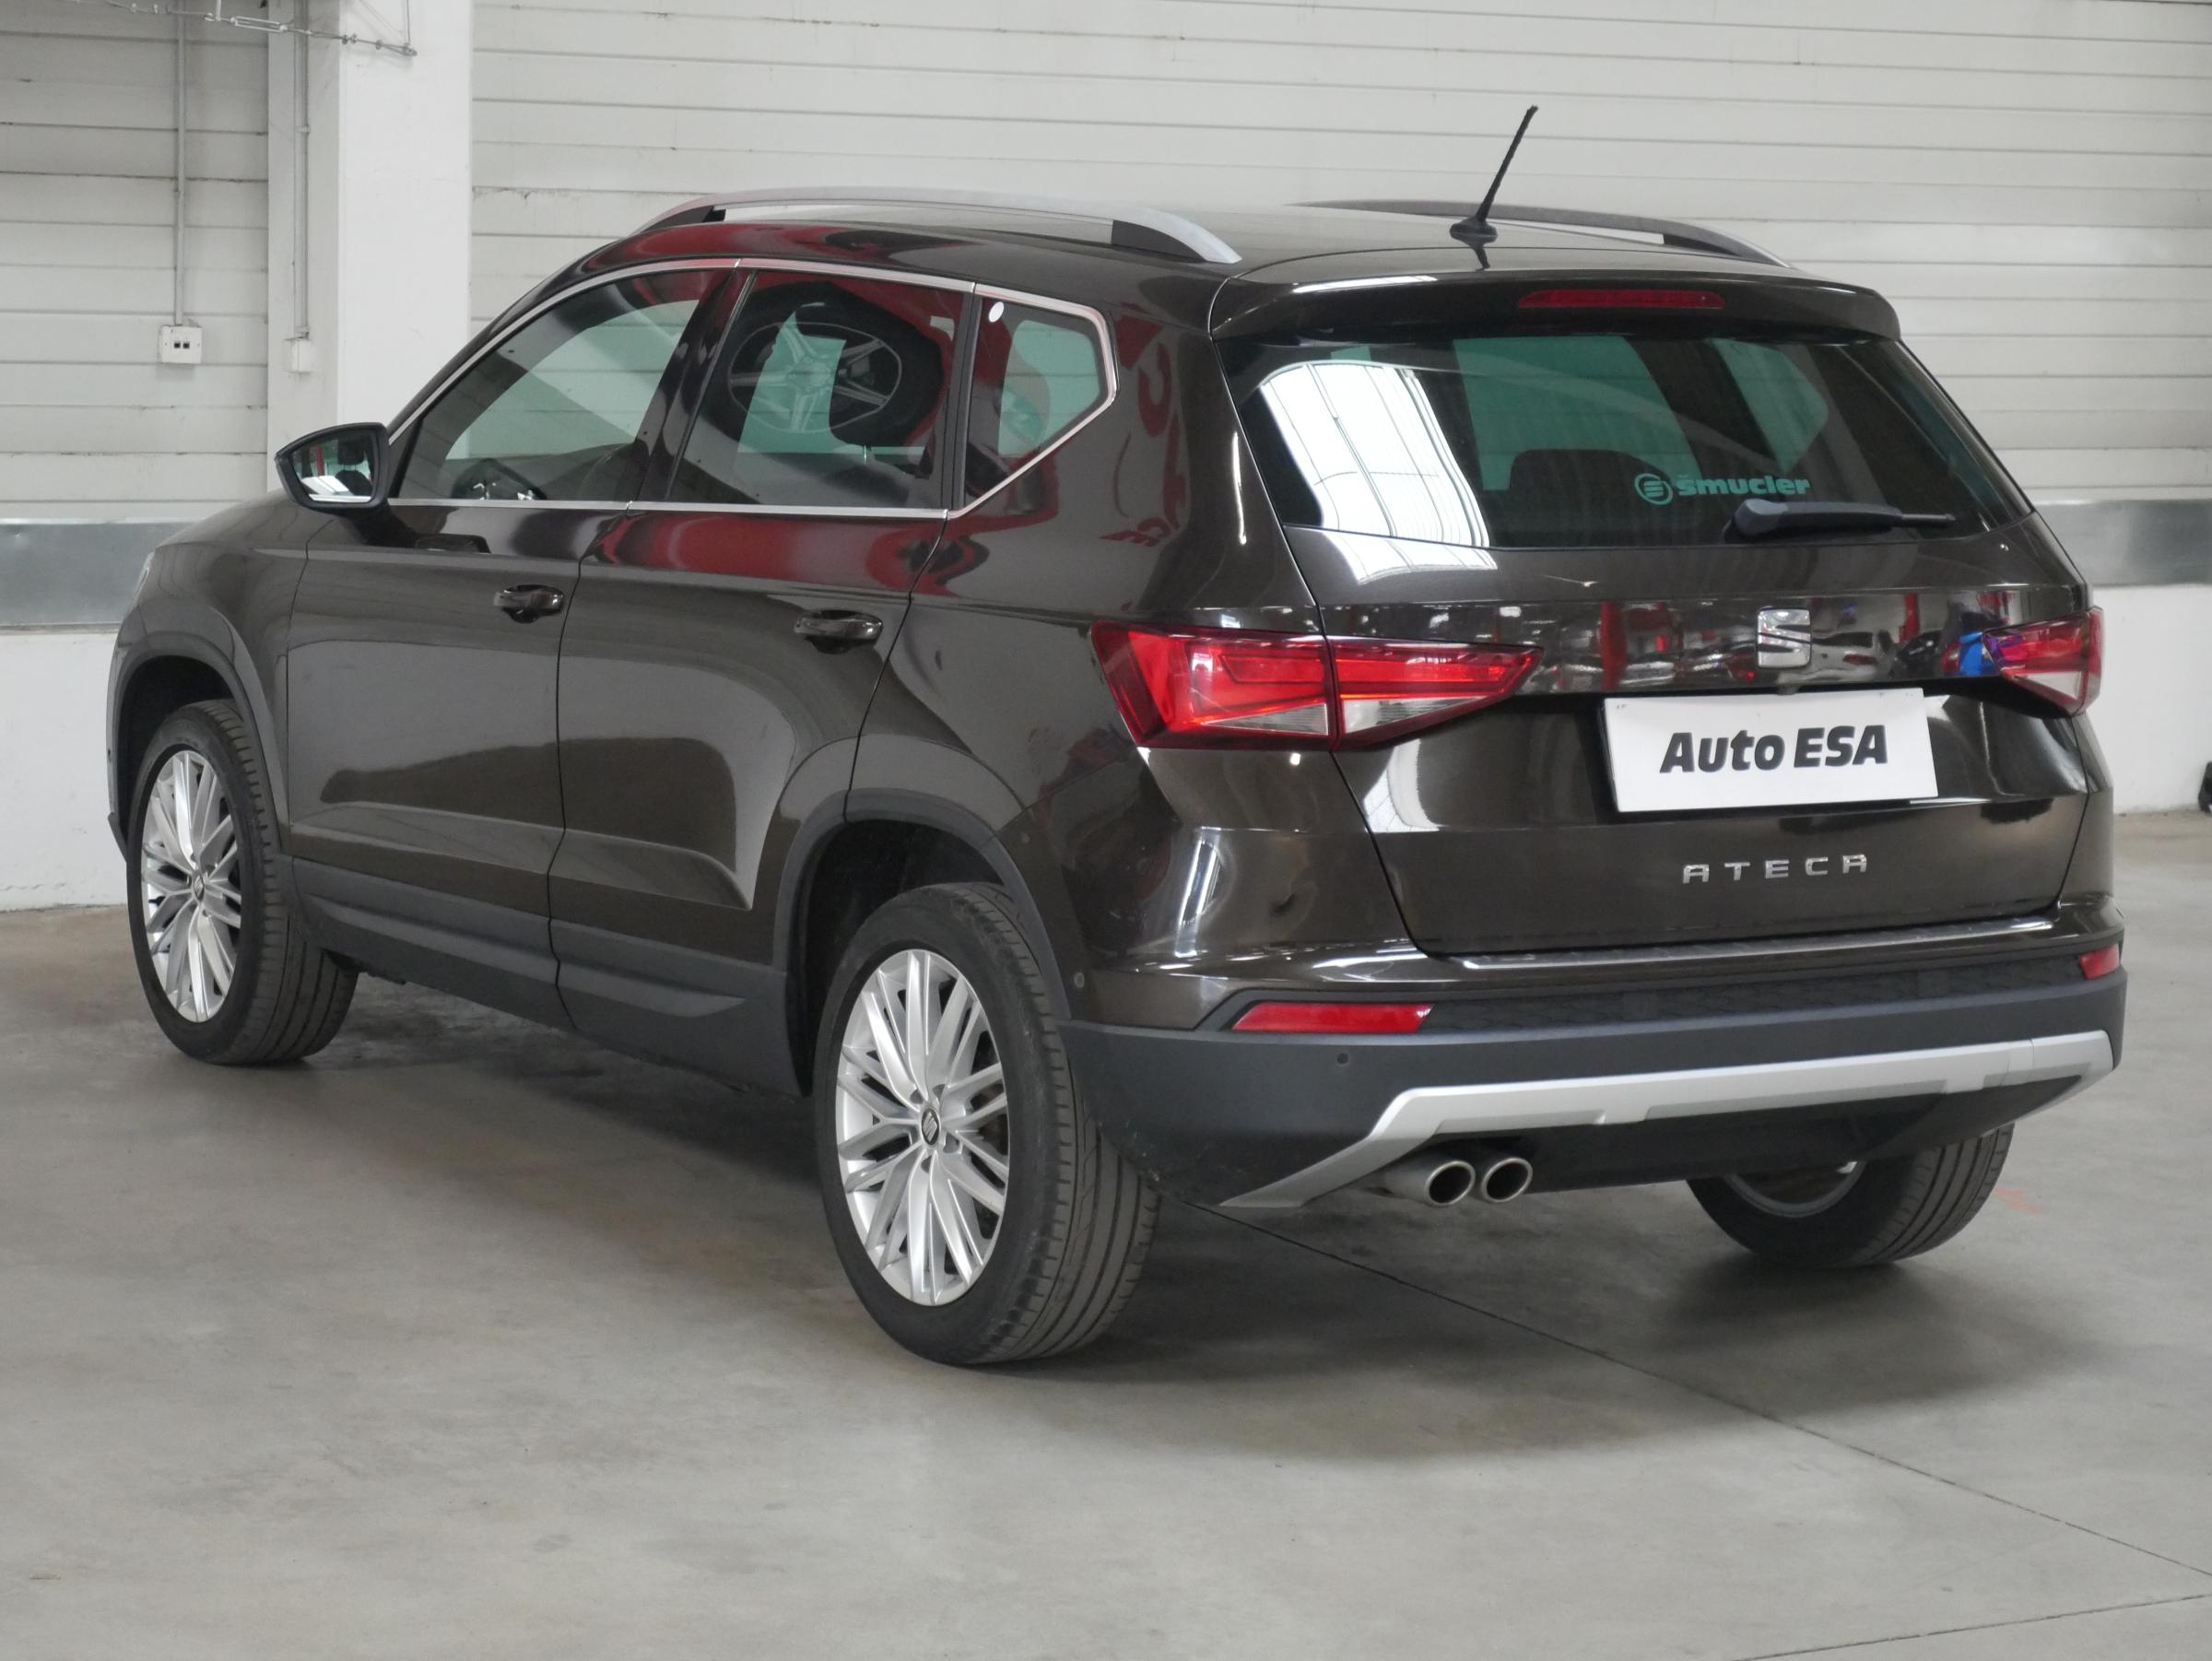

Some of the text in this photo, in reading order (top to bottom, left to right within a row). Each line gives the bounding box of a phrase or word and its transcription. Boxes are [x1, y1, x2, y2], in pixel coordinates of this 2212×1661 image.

[1660, 724, 1888, 773] Auto ESA
[1683, 854, 1867, 884] ATECA
